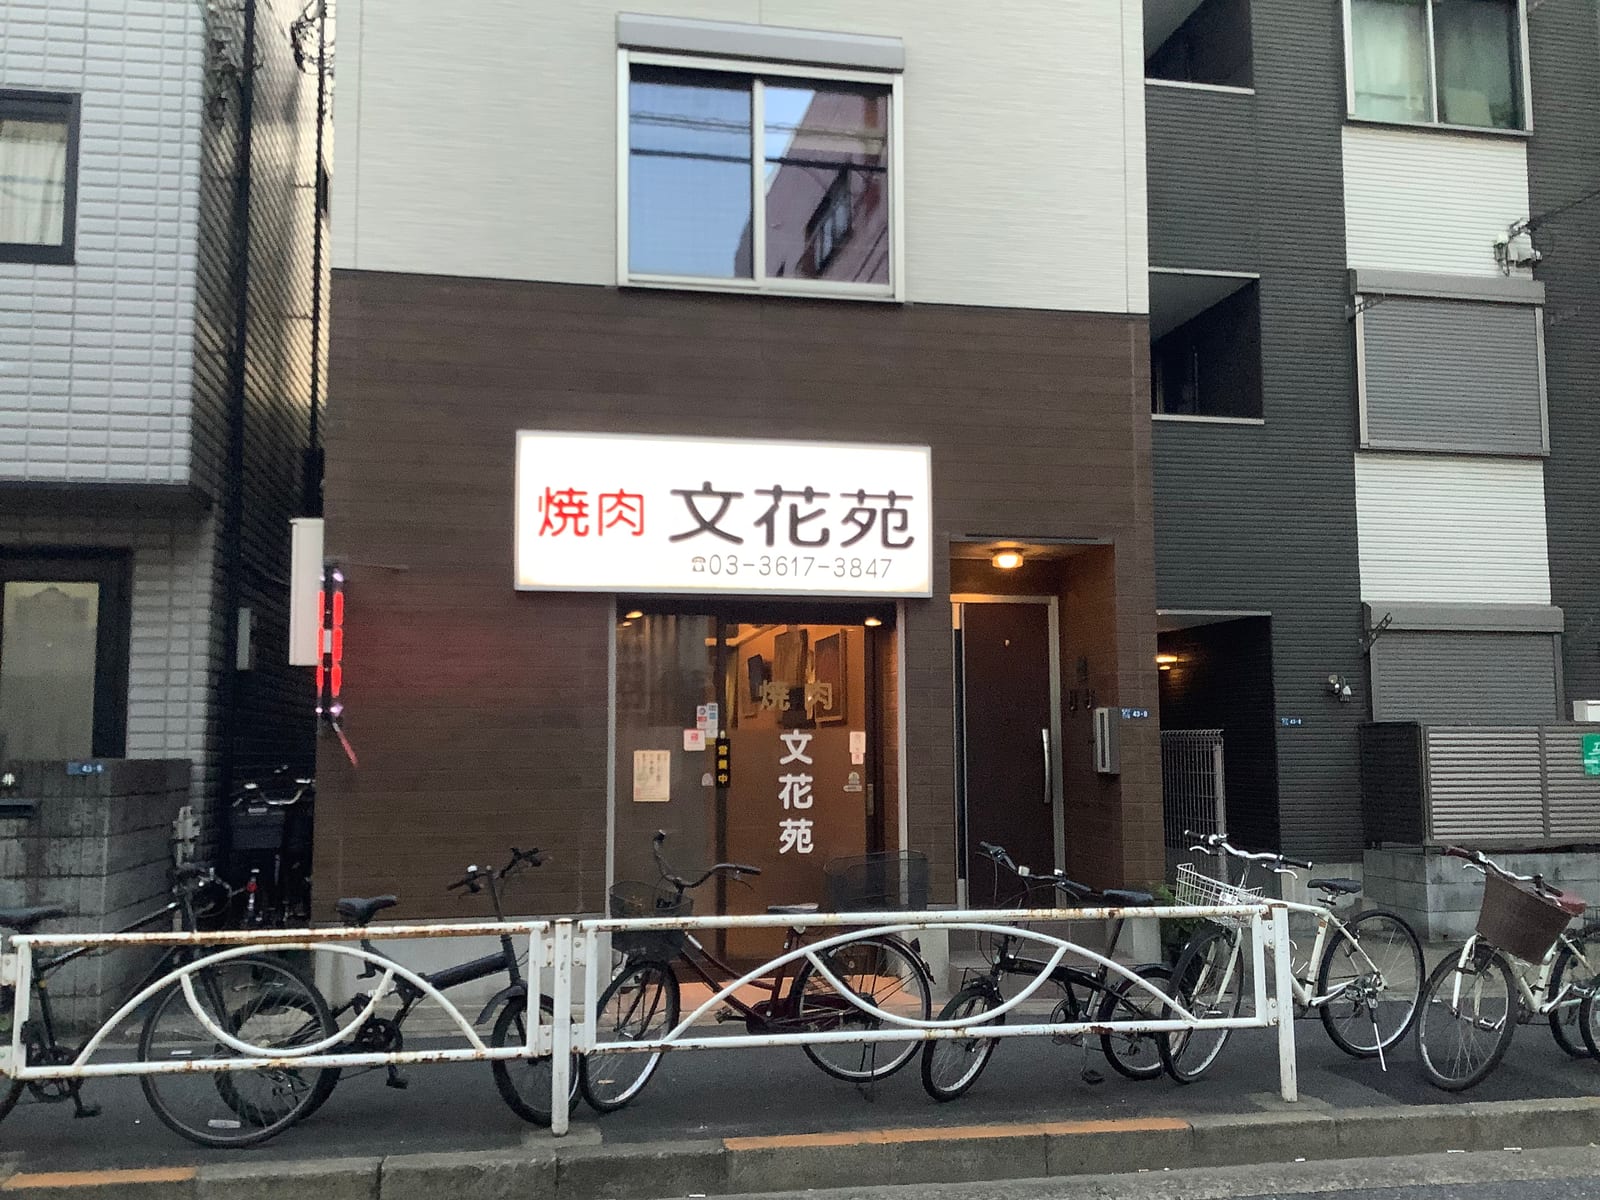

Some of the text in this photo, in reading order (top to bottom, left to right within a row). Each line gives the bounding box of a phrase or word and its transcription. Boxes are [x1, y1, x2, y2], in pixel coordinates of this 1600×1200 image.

[538, 481, 915, 549] 焼肉 文花苑
[709, 554, 893, 578] 03-3617-3847
[758, 679, 833, 711] 焼肉
[778, 729, 814, 854] 文花苑
